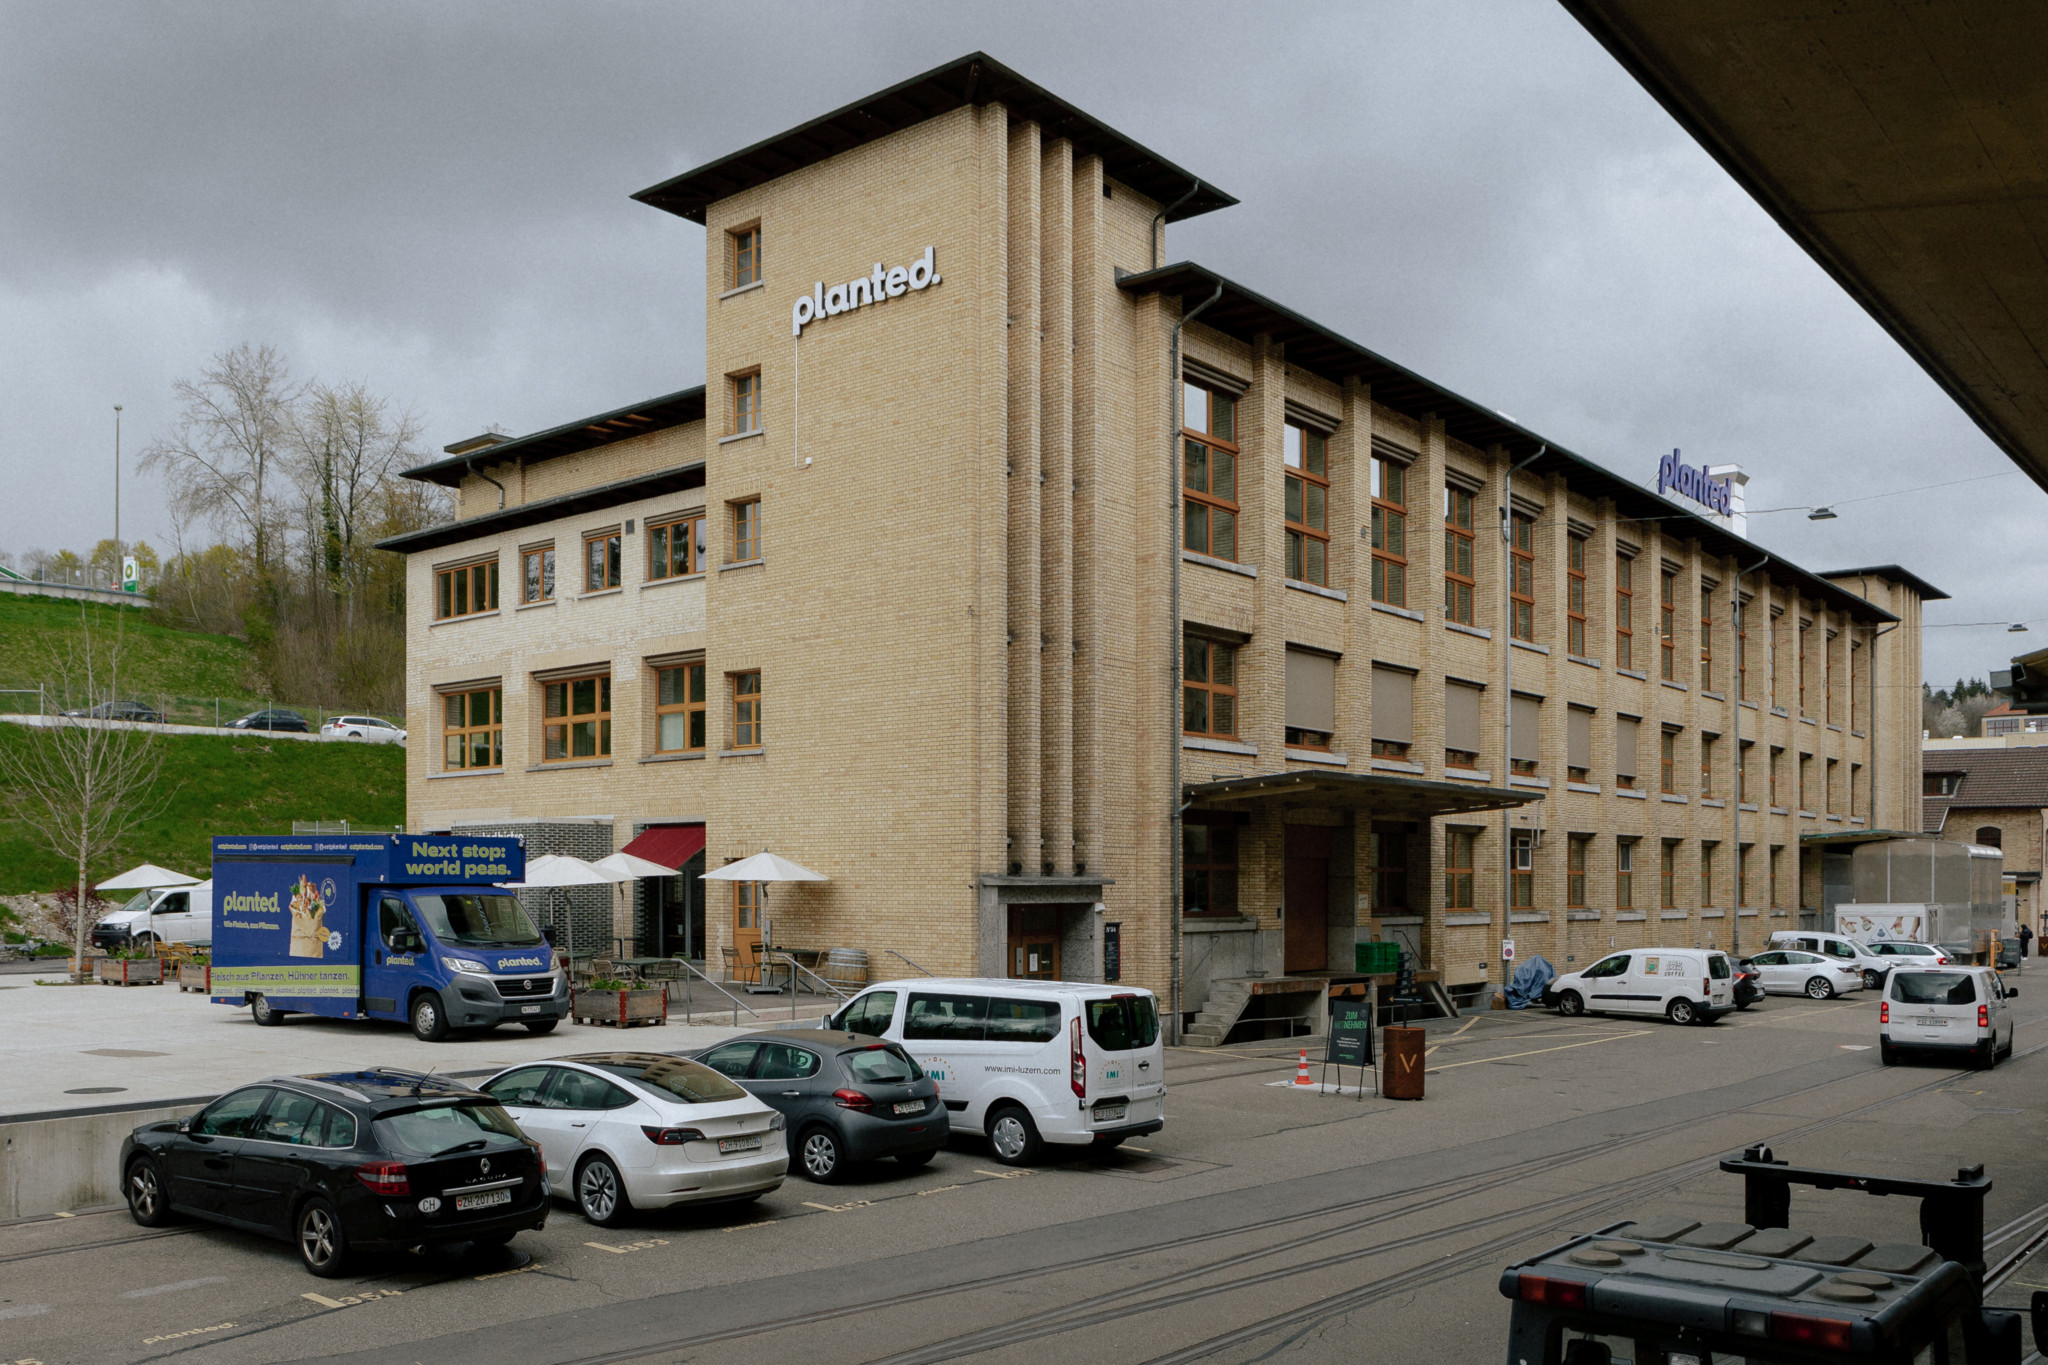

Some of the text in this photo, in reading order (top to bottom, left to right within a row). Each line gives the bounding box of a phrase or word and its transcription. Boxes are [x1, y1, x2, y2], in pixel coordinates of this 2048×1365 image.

[793, 246, 941, 336] planted.
[1658, 448, 1733, 518] planted.
[412, 842, 506, 861] Next stop:
[405, 860, 512, 879] world peas.
[223, 891, 280, 915] planted.
[386, 956, 415, 966] planted.
[497, 957, 543, 970] planted.
[236, 973, 249, 981] aus
[288, 970, 317, 981] Hühner
[320, 972, 350, 981] tanzen.
[1345, 1011, 1358, 1020] ZUM
[984, 1064, 1061, 1076] www.imi-luzern.com
[1106, 1070, 1119, 1079] IMI
[422, 1199, 436, 1211] CH
[462, 1196, 473, 1208] ZH
